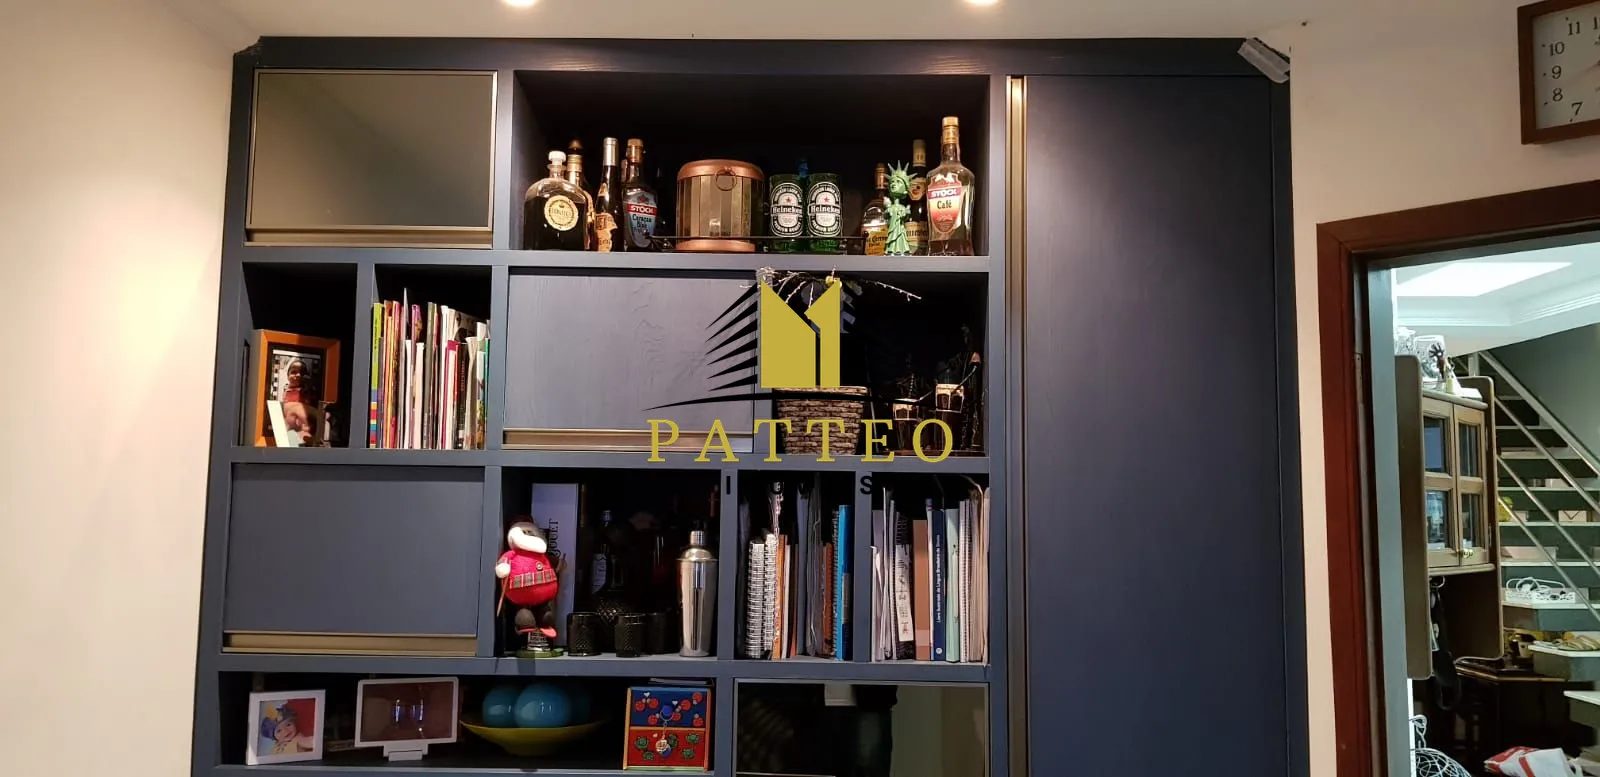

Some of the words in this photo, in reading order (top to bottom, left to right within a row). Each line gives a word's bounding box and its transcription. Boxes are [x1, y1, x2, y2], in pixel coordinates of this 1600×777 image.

[1568, 21, 1581, 36] 11
[1549, 41, 1565, 56] 10
[1552, 65, 1562, 79] 9
[1552, 87, 1563, 102] 8
[1571, 101, 1583, 116] 7
[931, 189, 957, 198] STOCK
[630, 205, 654, 214] STOCK
[937, 200, 952, 209] Café
